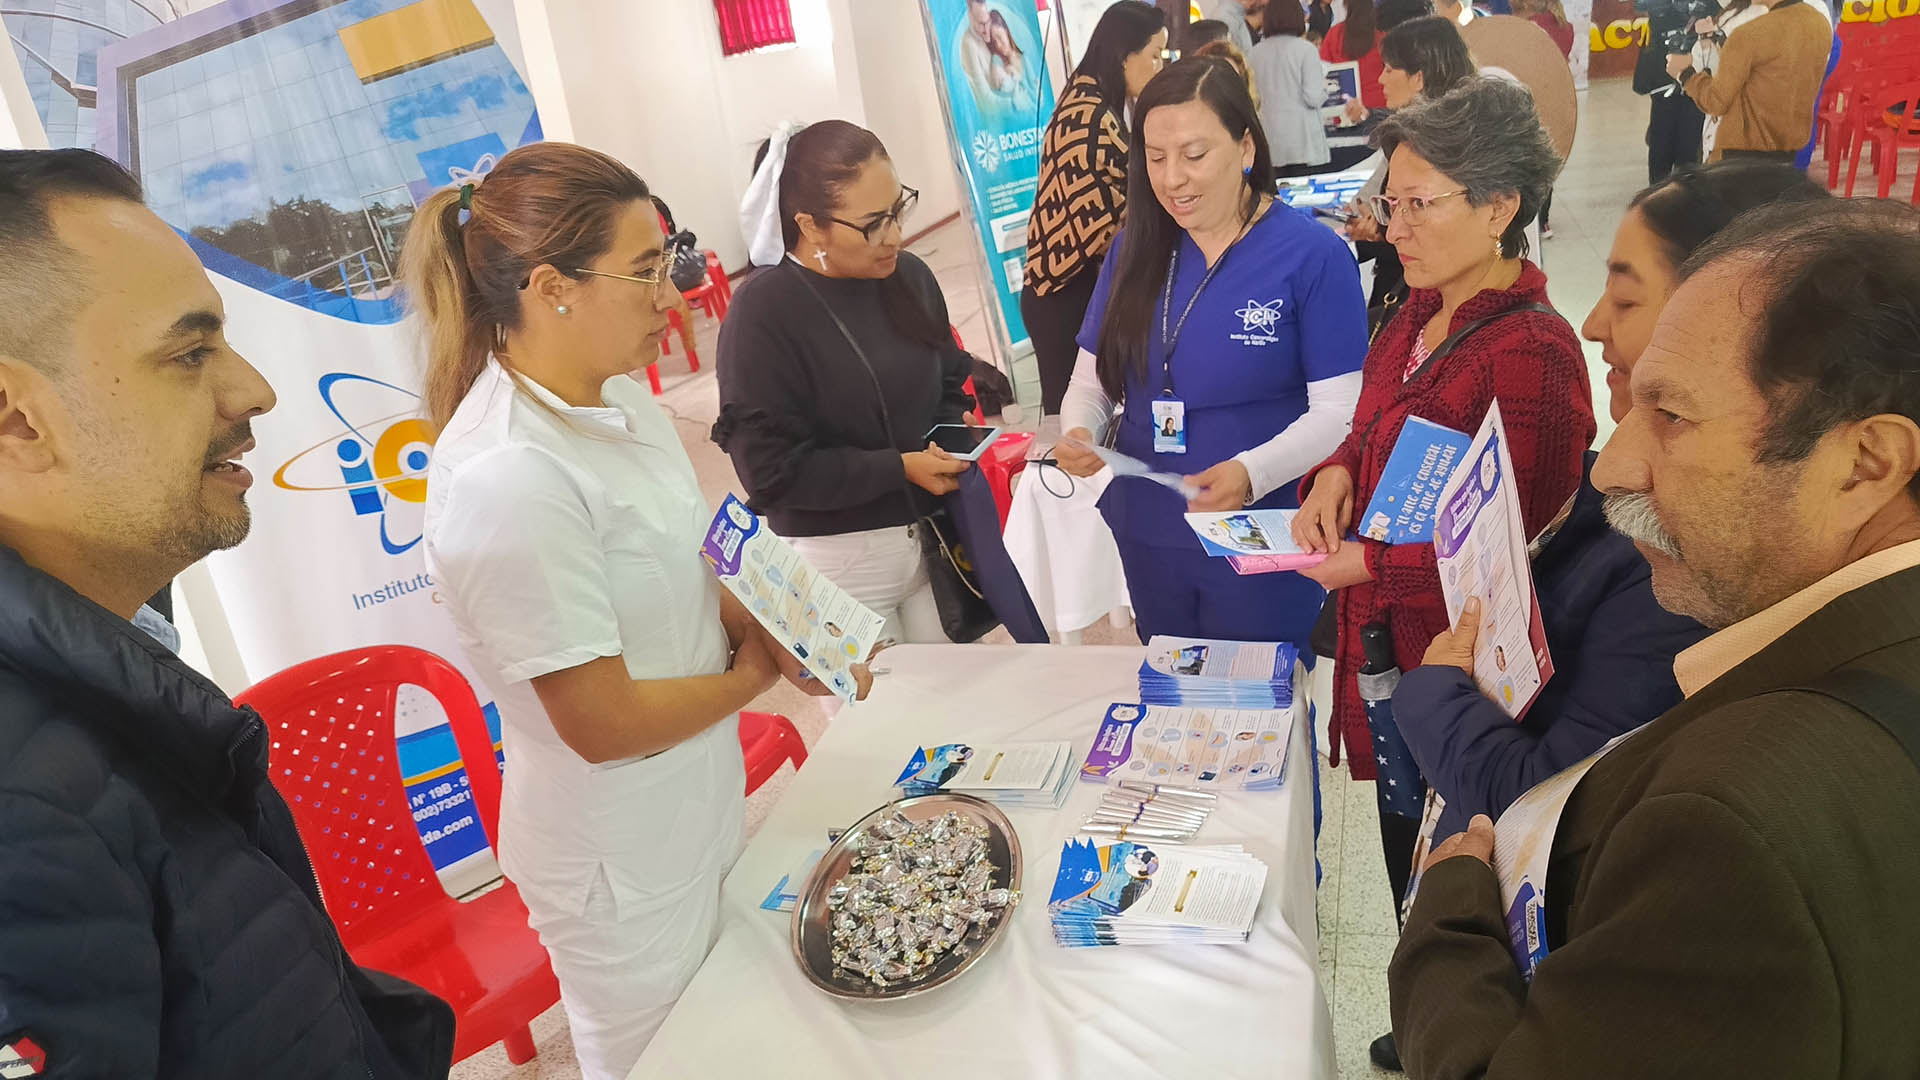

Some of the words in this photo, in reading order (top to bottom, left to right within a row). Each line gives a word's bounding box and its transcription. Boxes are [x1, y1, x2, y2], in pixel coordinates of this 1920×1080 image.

[1434, 444, 1457, 477] ayudar
[1411, 481, 1425, 495] de
[1428, 478, 1442, 491] de
